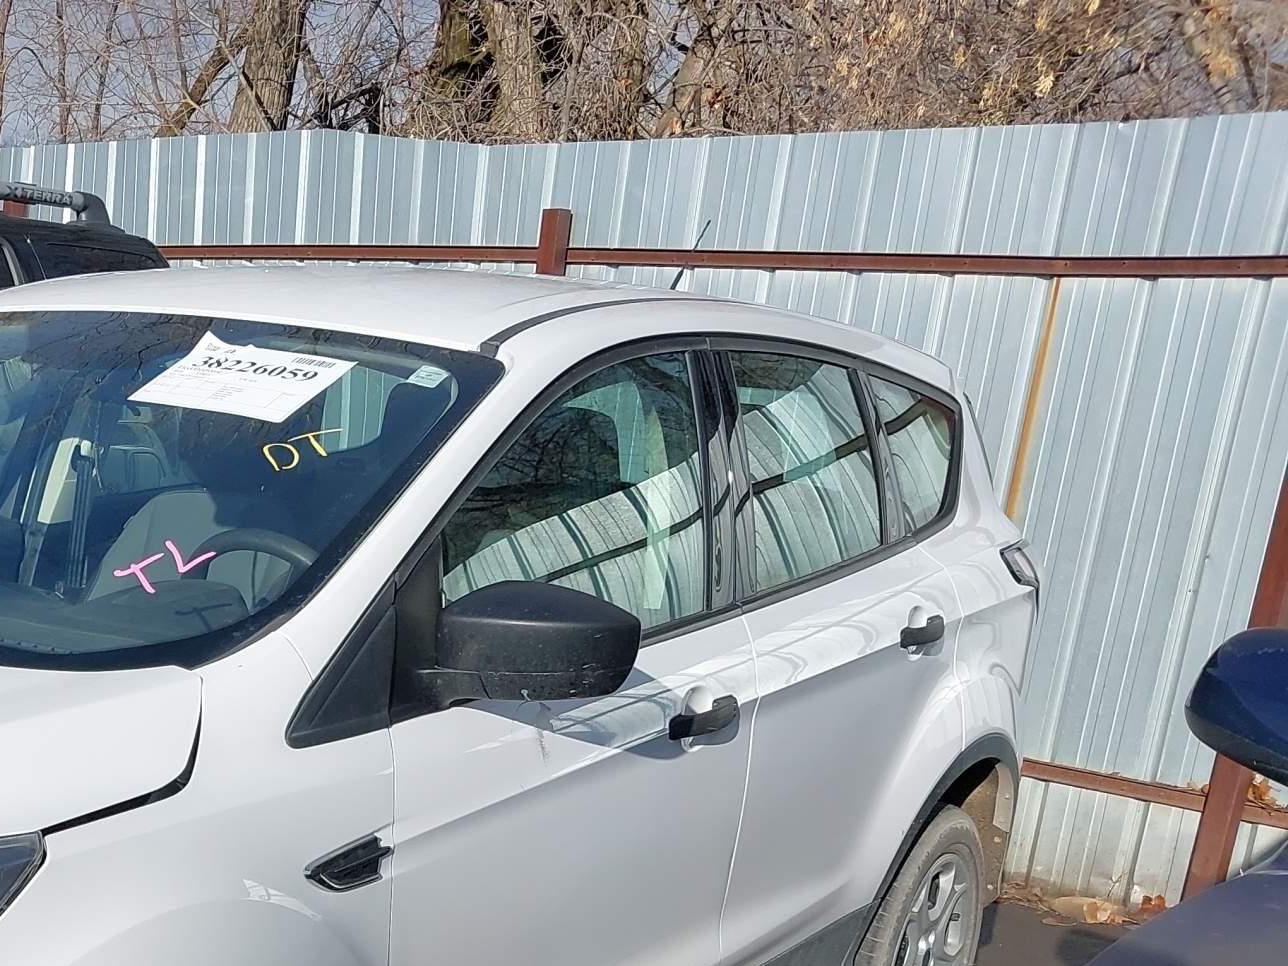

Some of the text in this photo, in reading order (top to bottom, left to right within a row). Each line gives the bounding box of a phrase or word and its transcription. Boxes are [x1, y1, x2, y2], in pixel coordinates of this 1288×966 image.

[6, 184, 73, 206] XTERRA
[192, 356, 319, 382] 38226059
[262, 427, 344, 472] DT
